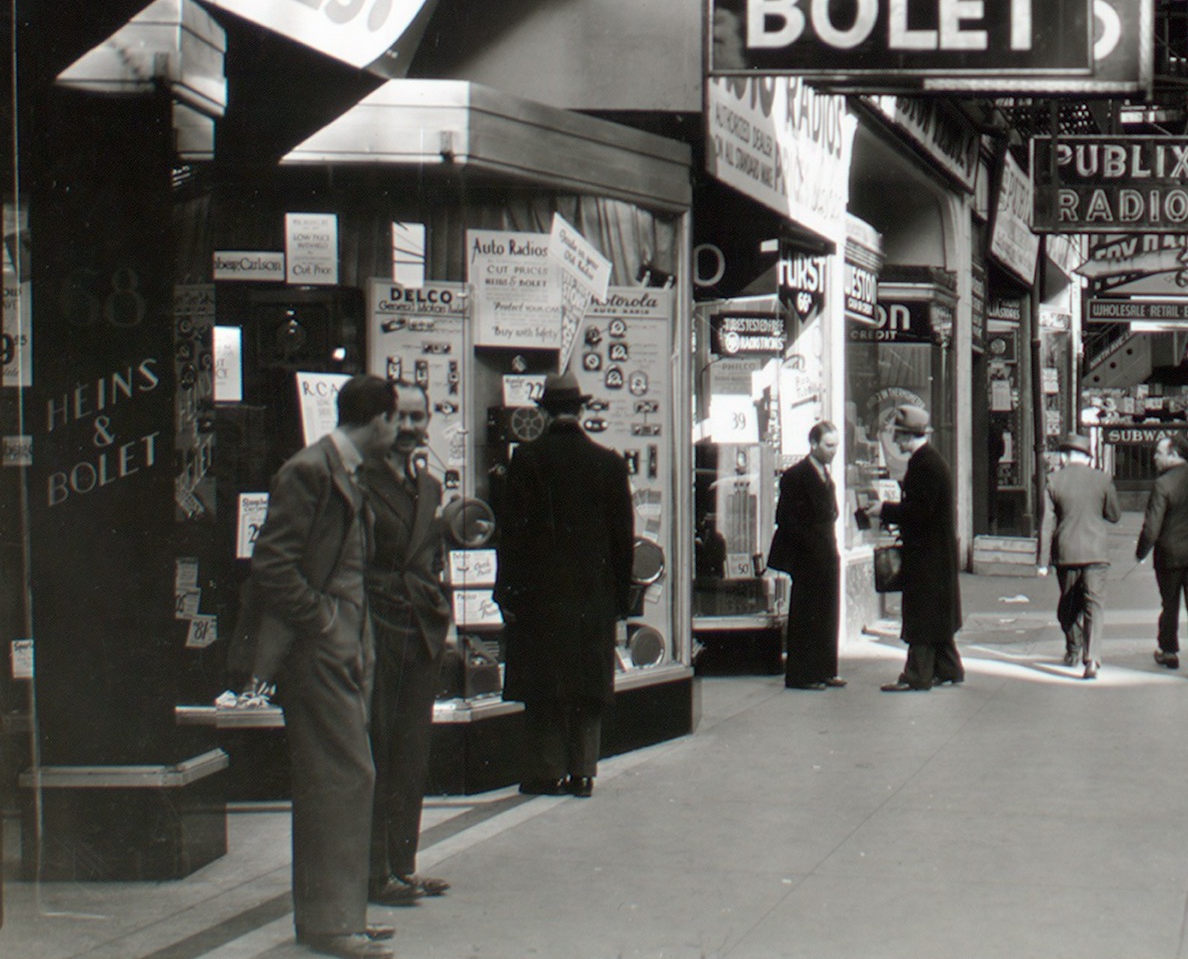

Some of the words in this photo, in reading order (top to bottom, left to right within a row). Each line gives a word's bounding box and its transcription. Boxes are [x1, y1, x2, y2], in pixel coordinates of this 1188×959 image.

[472, 237, 505, 263] Auto
[508, 239, 549, 257] Radios
[487, 264, 509, 275] CUT
[514, 265, 549, 276] PRICES
[391, 287, 453, 303] DELCO
[1093, 305, 1145, 318] WHOLESALE
[1150, 306, 1179, 318] RETAIL
[850, 330, 898, 340] CREDIT
[48, 358, 160, 432] HEINS
[732, 412, 747, 431] 39
[93, 415, 115, 447] &
[1109, 429, 1178, 443] SUBWAY
[48, 431, 161, 507] BOLET
[738, 563, 748, 574] 50
